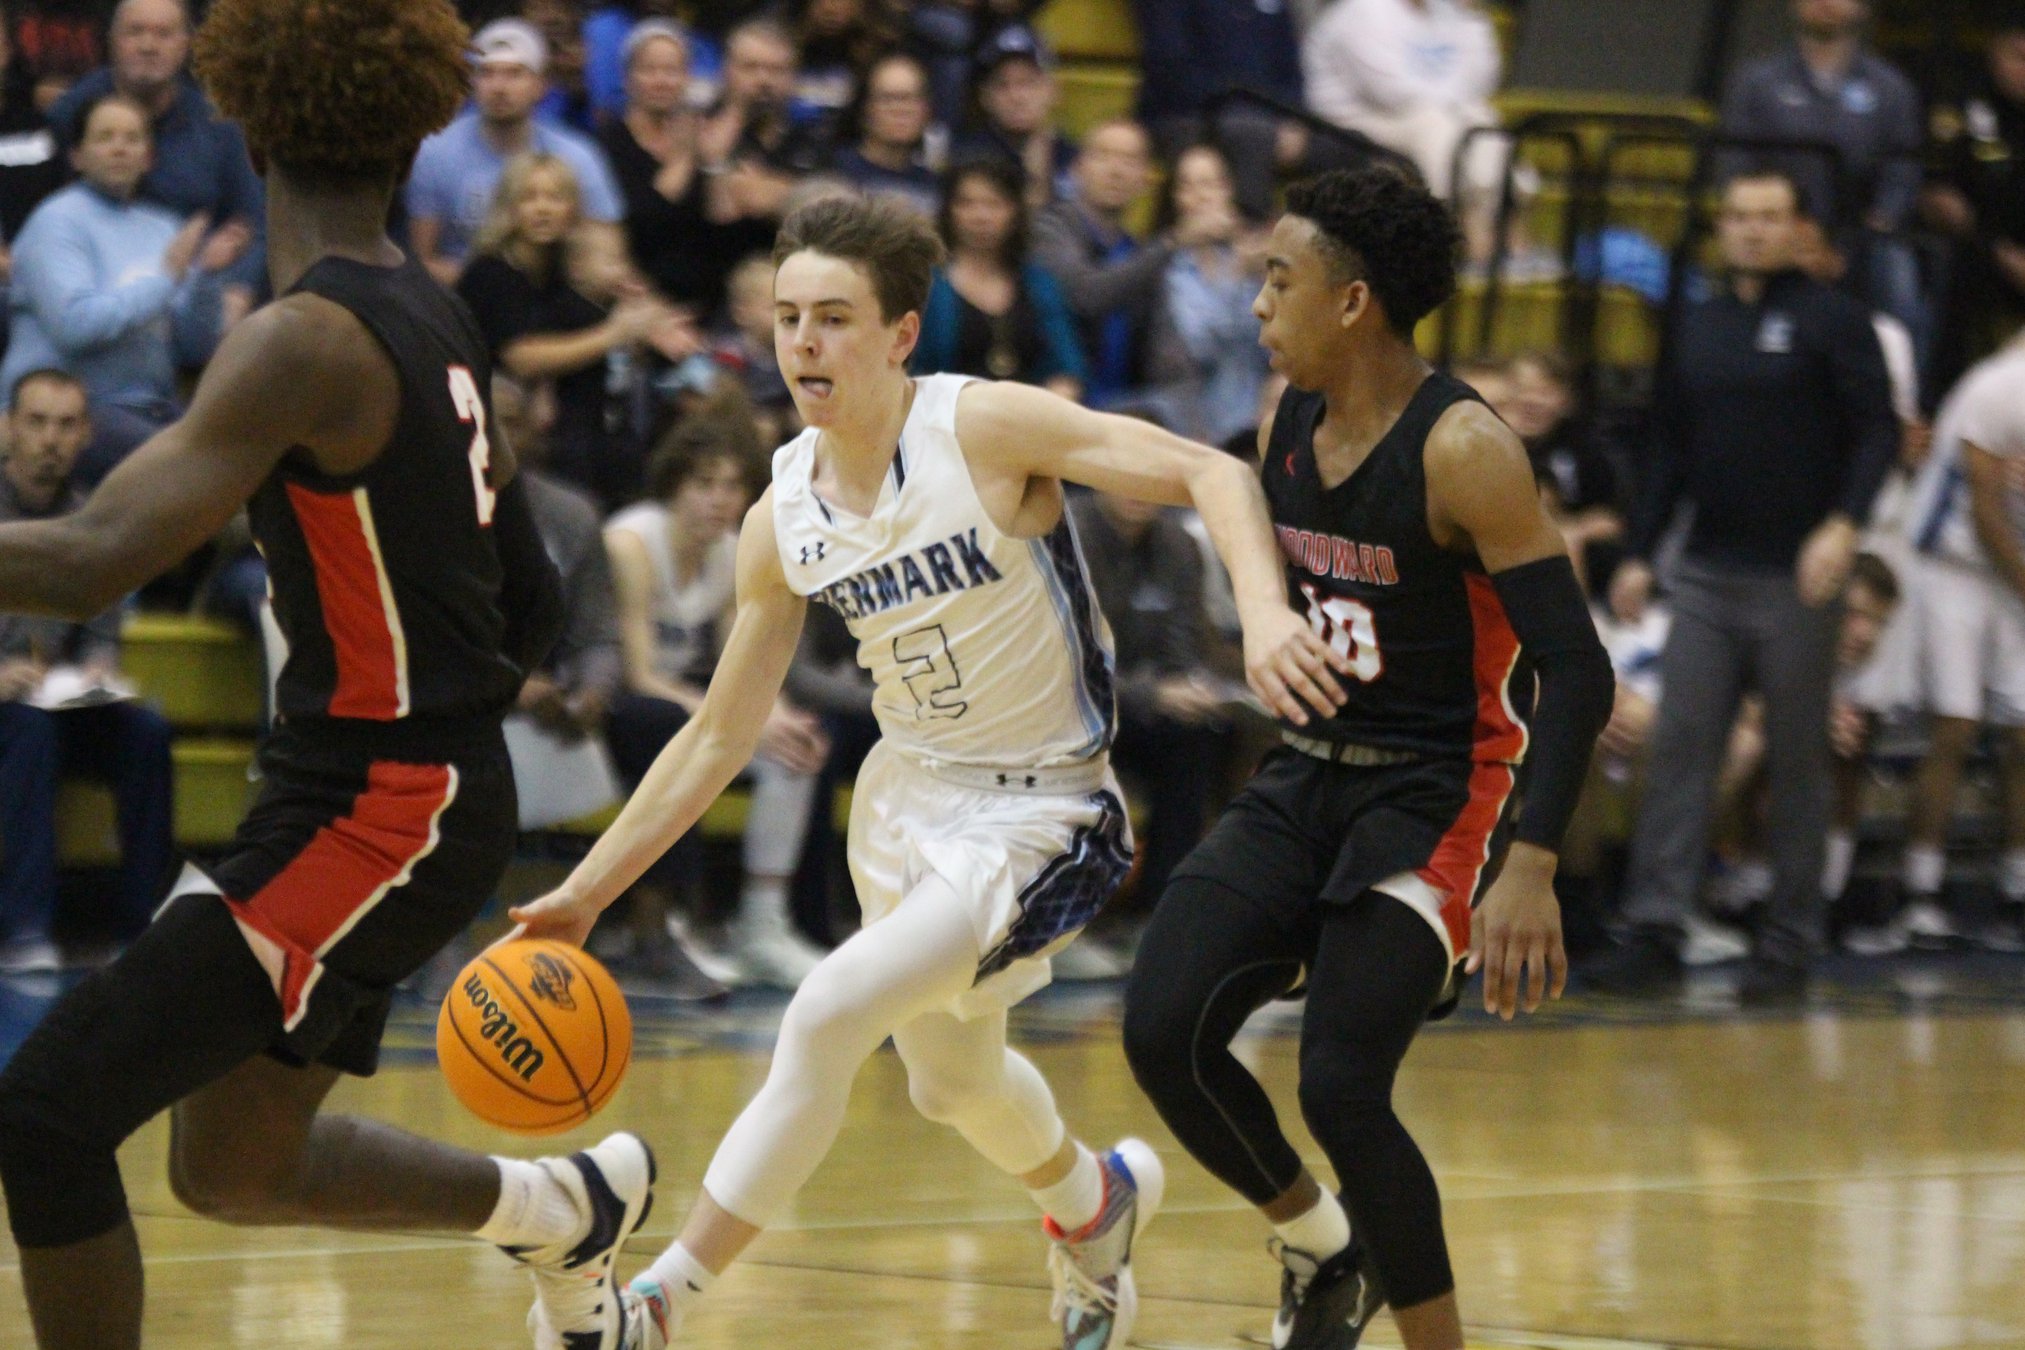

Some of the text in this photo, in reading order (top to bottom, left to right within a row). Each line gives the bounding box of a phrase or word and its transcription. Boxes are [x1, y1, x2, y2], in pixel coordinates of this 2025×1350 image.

[447, 363, 497, 528] 2
[1275, 523, 1399, 585] OODWARD
[891, 623, 968, 720] 2
[462, 972, 544, 1083] Wilson
